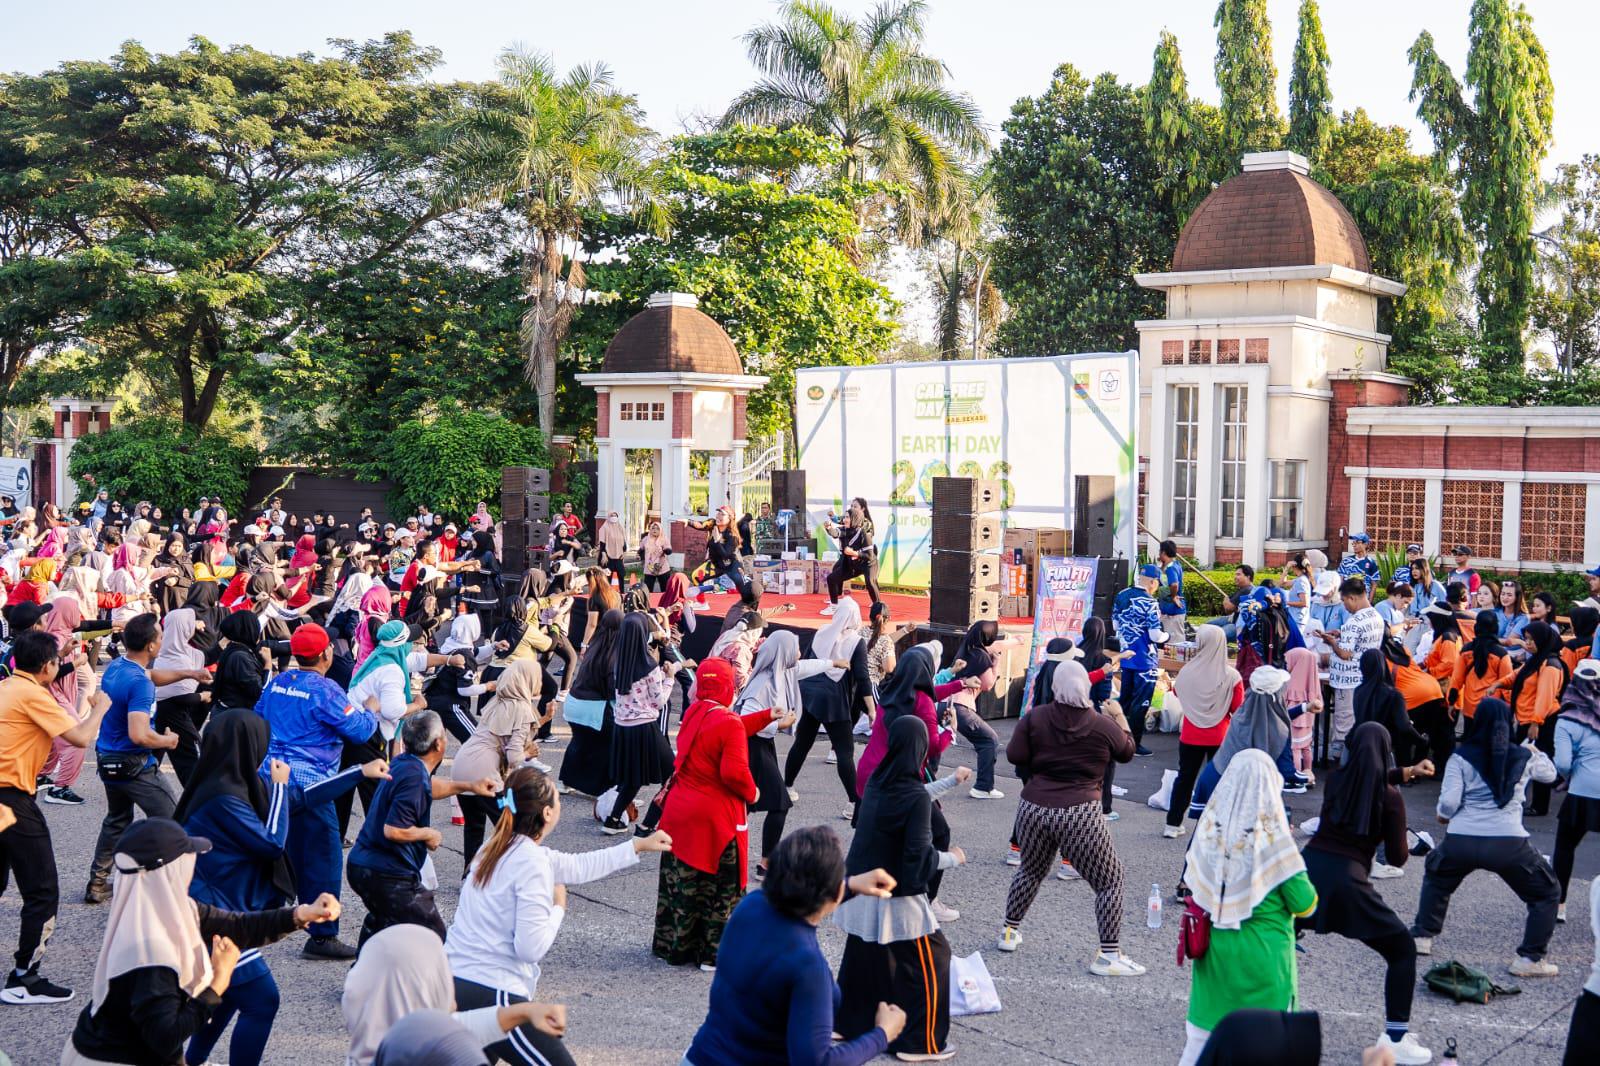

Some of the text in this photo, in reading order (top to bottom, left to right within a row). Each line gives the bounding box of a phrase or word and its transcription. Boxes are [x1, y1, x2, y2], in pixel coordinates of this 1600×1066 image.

[949, 381, 986, 400] FREE
[915, 400, 948, 419] DAY
[901, 435, 1000, 453] EARTH DAY
[888, 513, 908, 527] Our
[1046, 566, 1092, 582] FUN FIT
[1051, 581, 1077, 591] 2026
